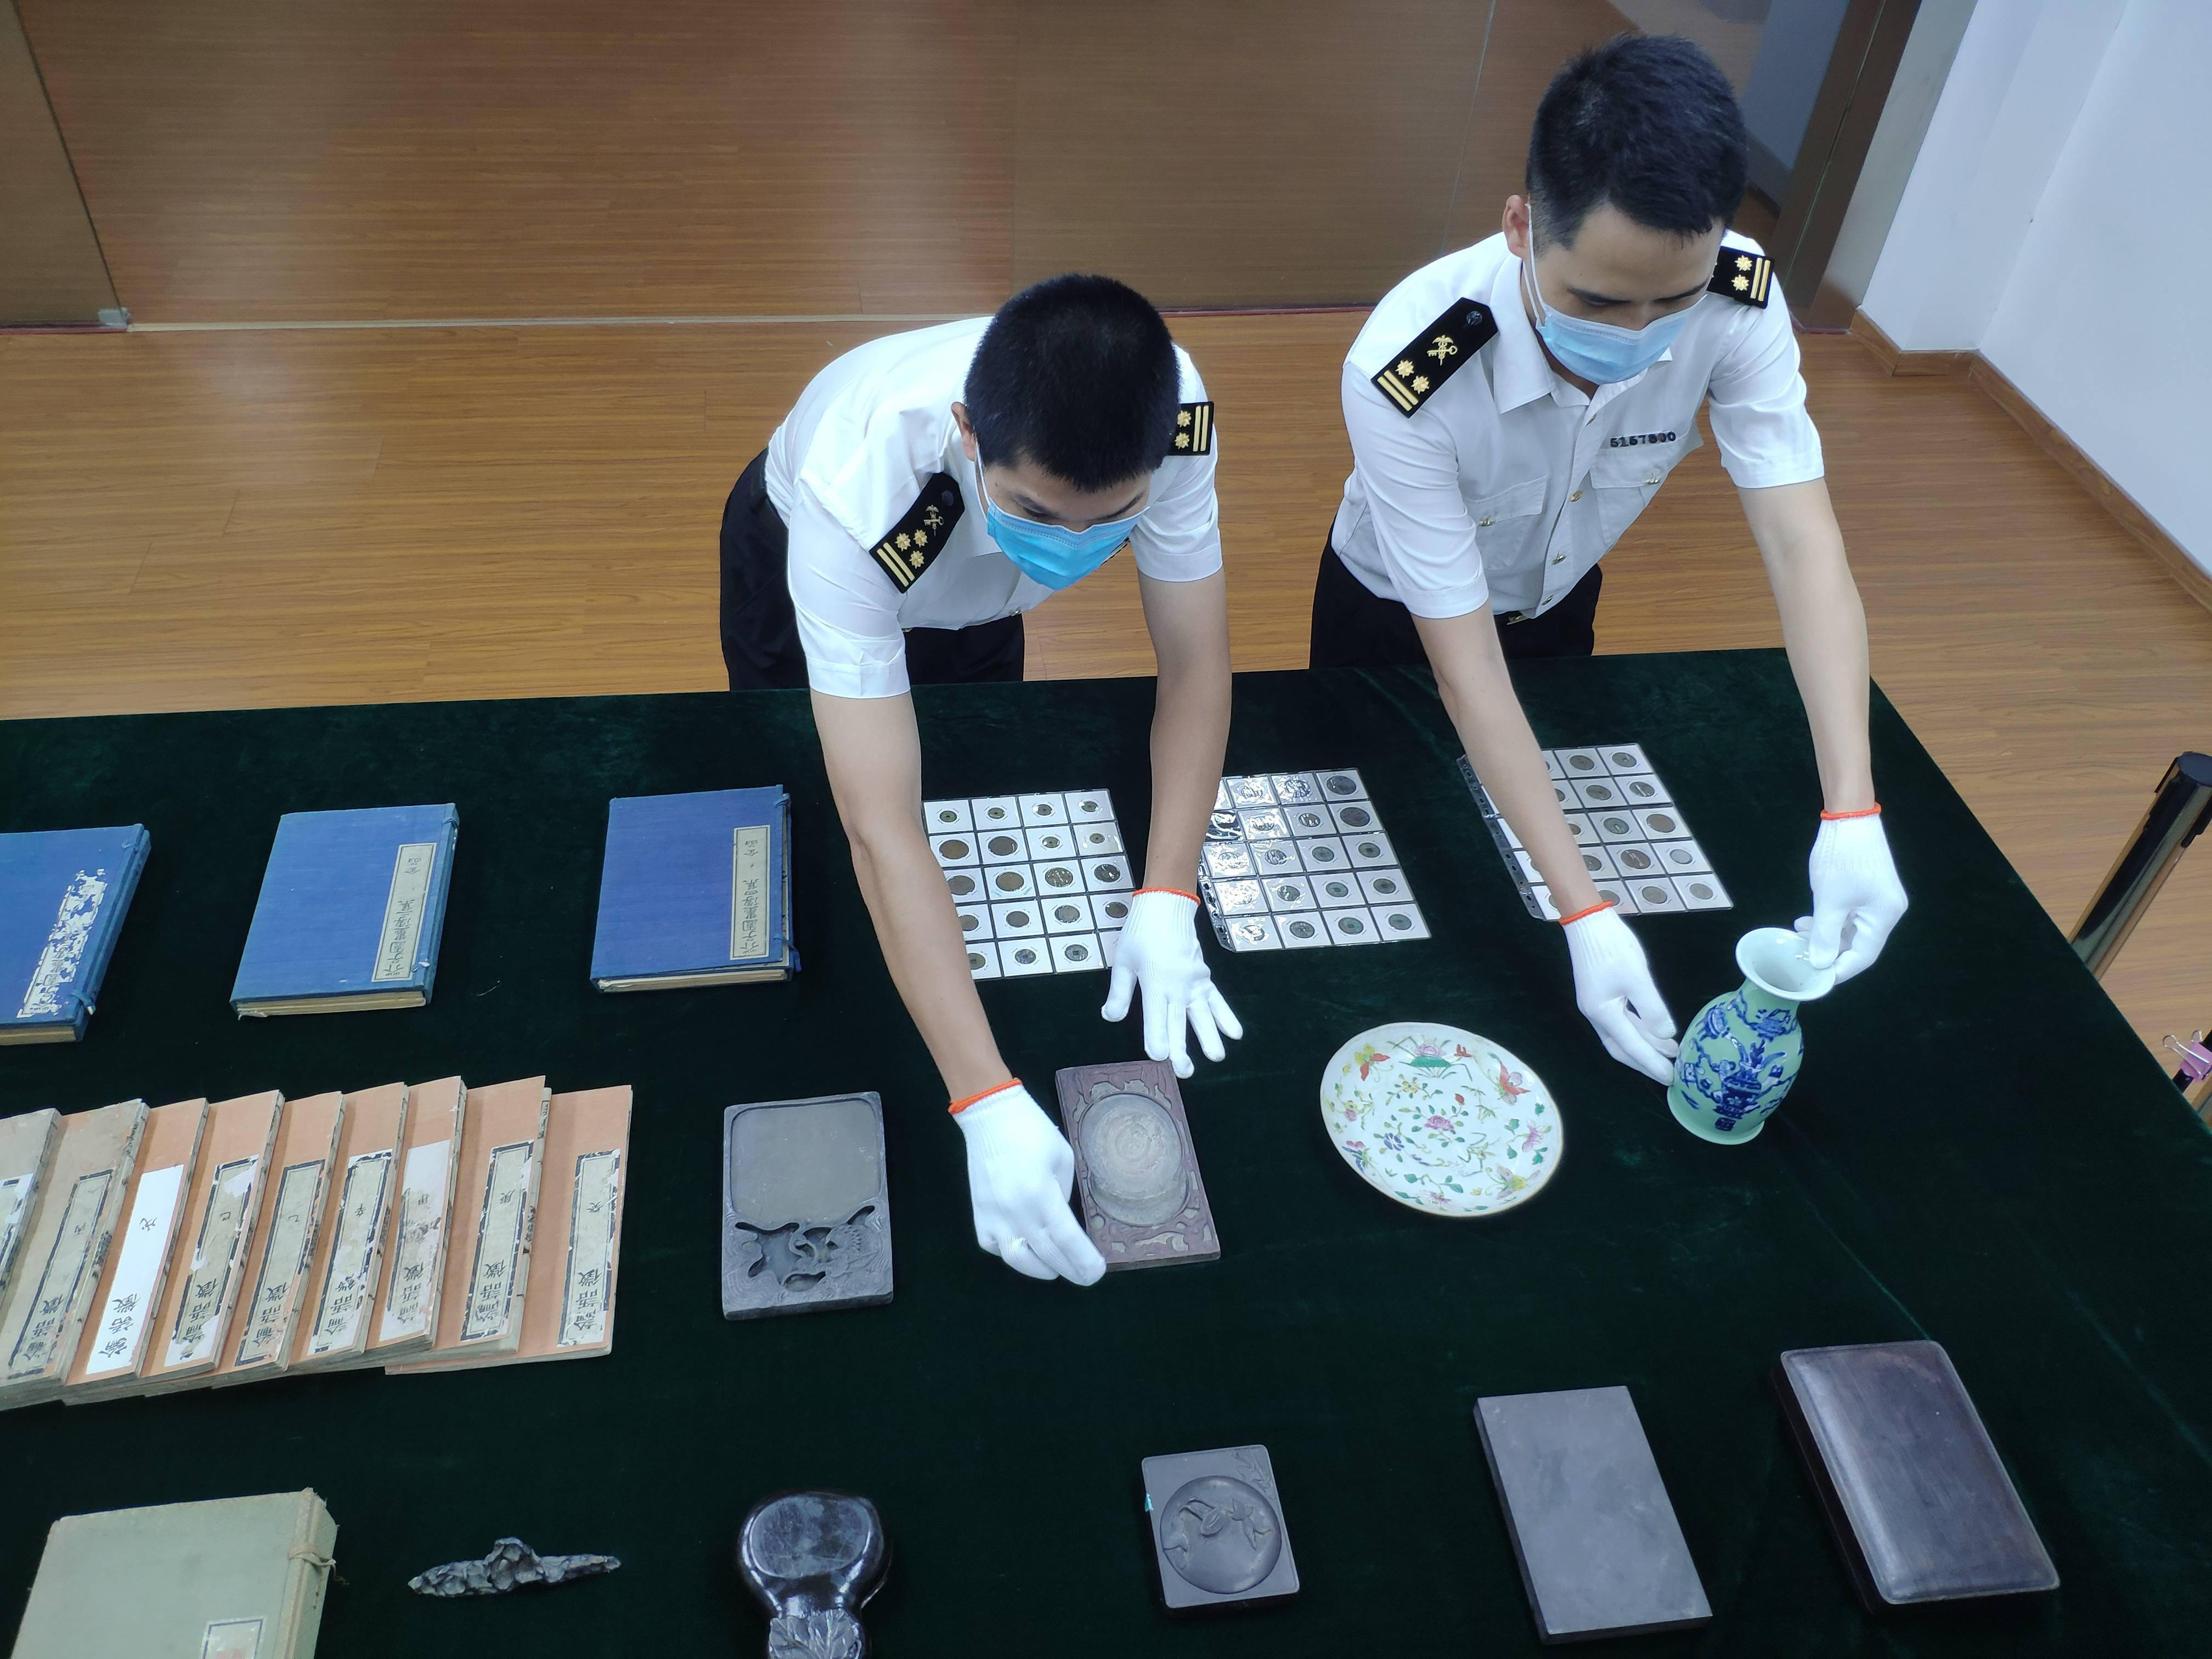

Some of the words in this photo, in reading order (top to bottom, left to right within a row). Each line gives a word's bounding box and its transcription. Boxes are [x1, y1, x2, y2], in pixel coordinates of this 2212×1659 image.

[74, 1222, 87, 1236] 丙
[417, 1193, 430, 1205] 甲
[181, 1277, 219, 1344] 論語徵
[249, 1281, 291, 1348] 論語徵
[474, 1259, 508, 1323] 論語徵
[98, 1293, 141, 1358] 論語徵
